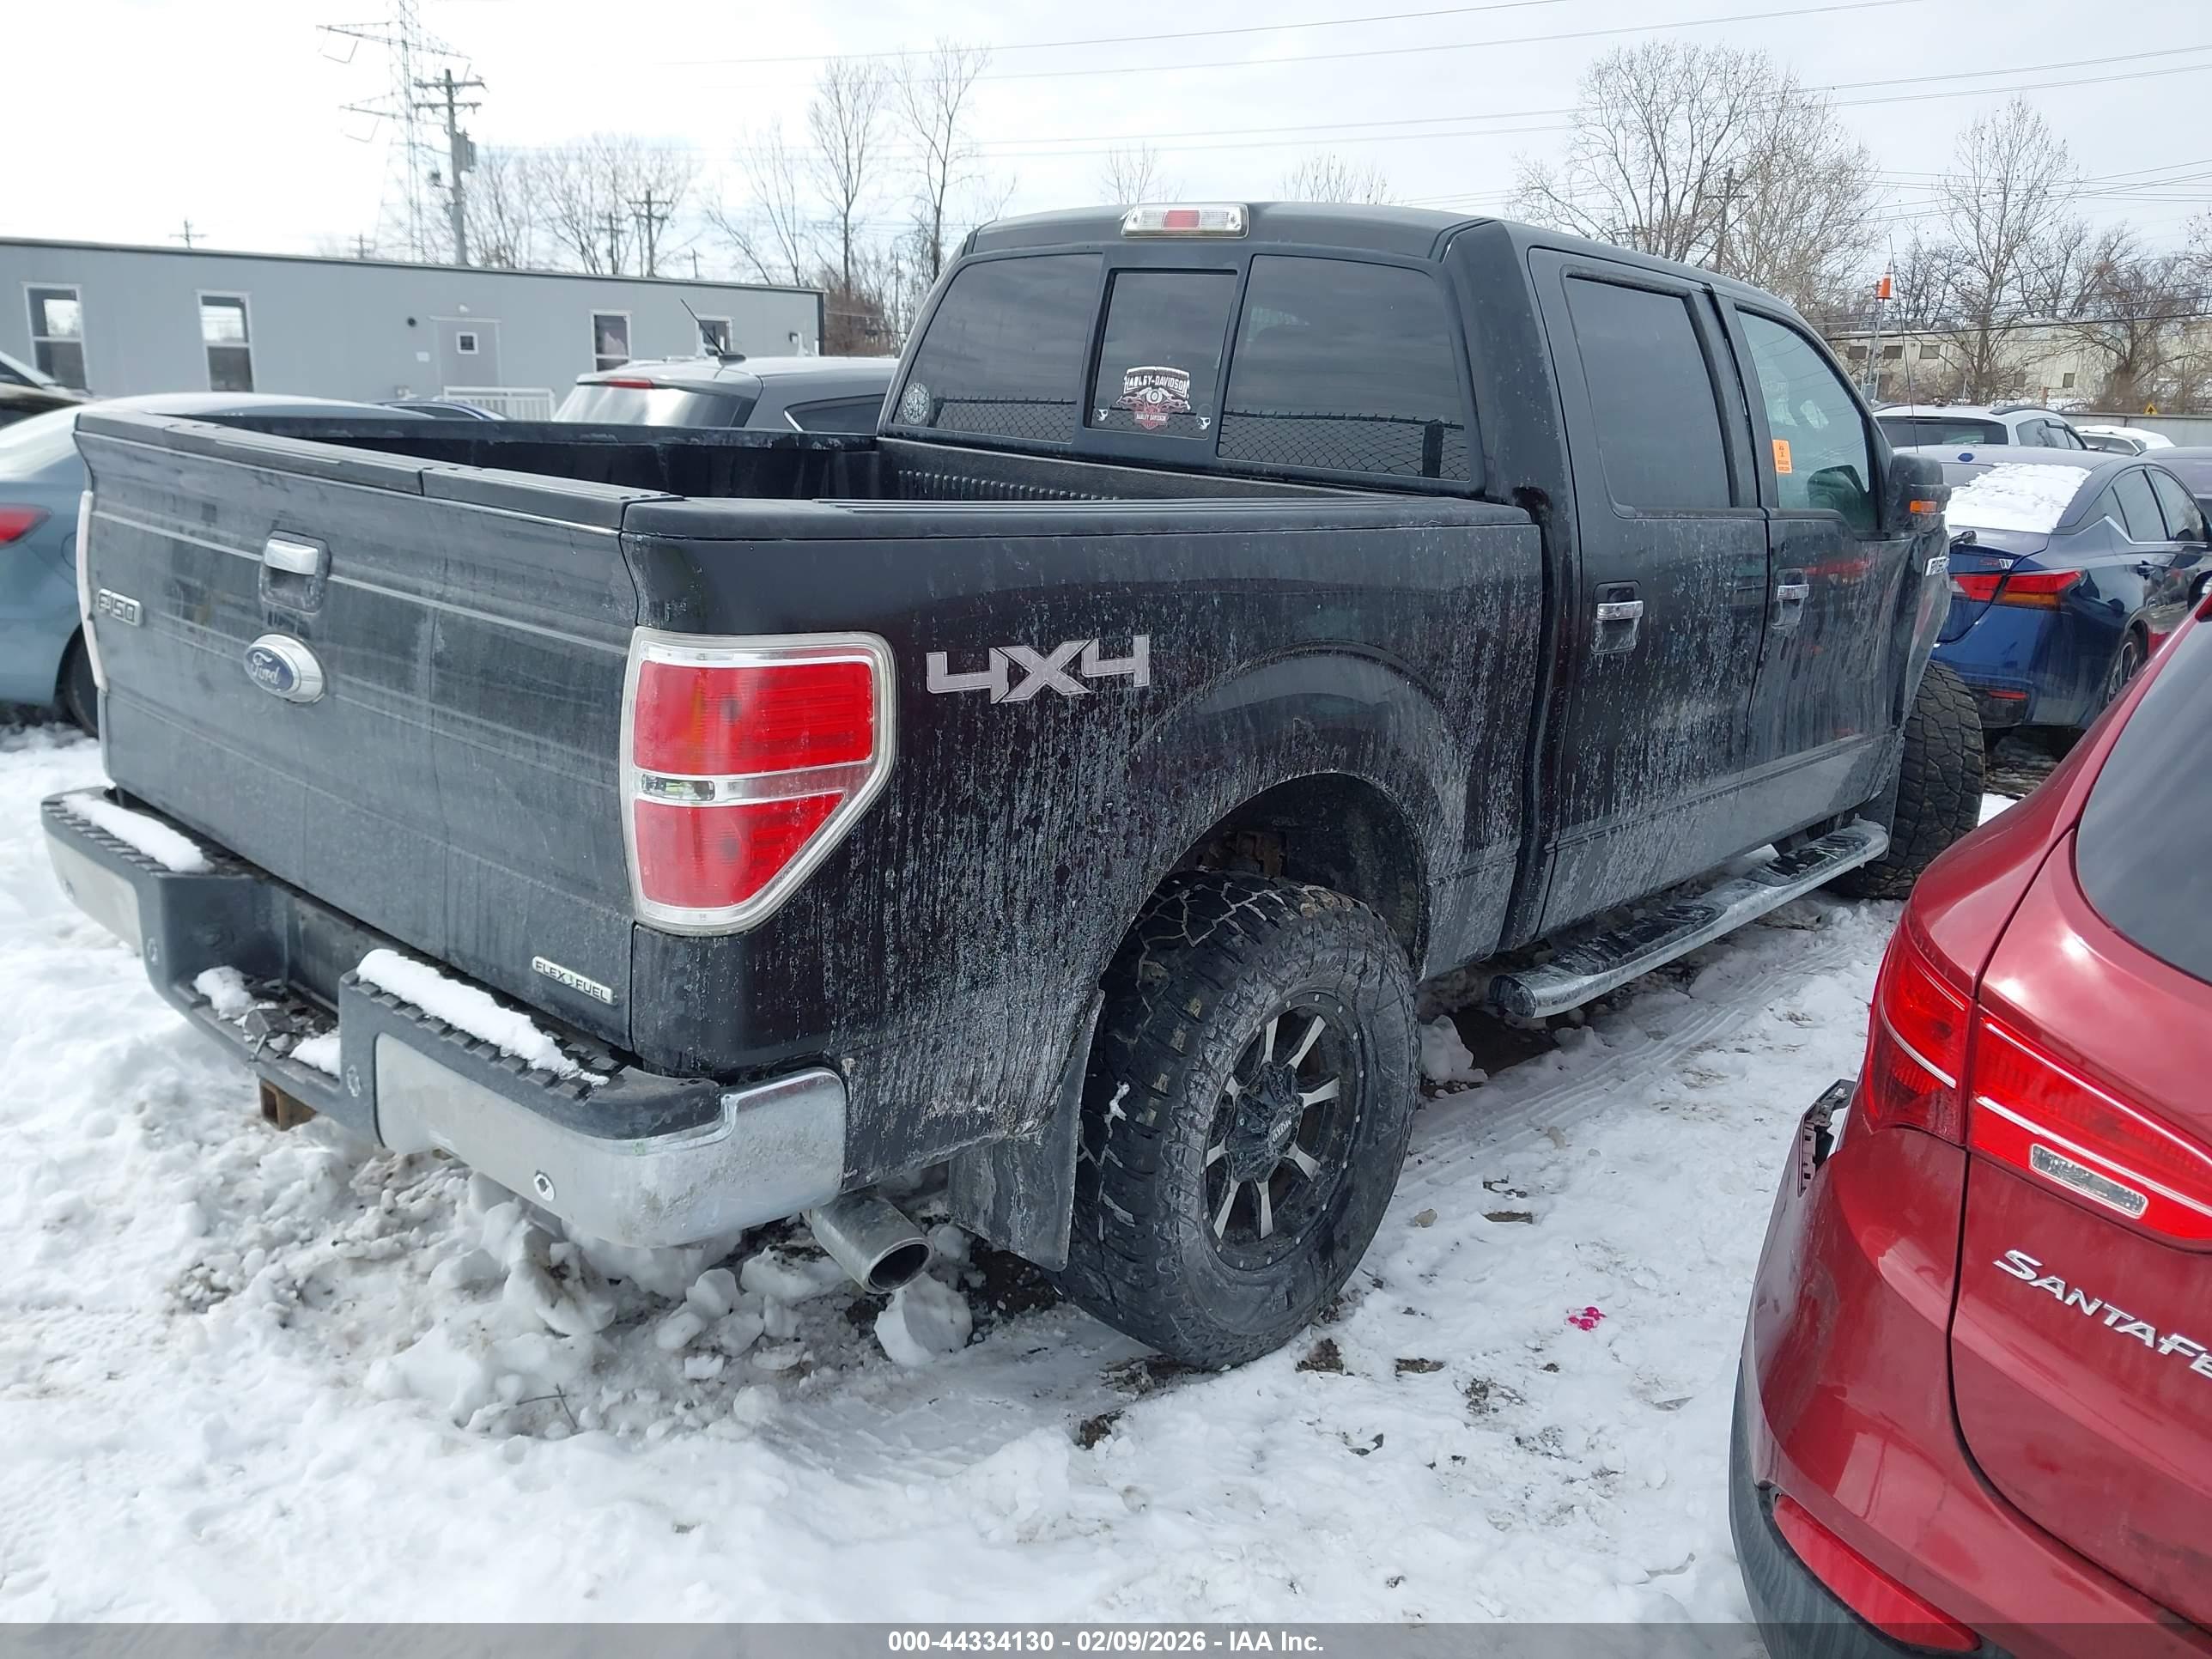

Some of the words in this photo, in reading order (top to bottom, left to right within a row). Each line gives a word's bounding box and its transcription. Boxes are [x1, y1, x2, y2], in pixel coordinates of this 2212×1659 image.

[252, 652, 280, 685] Ford
[535, 960, 566, 983] FLEX
[575, 978, 608, 1001] FUEL
